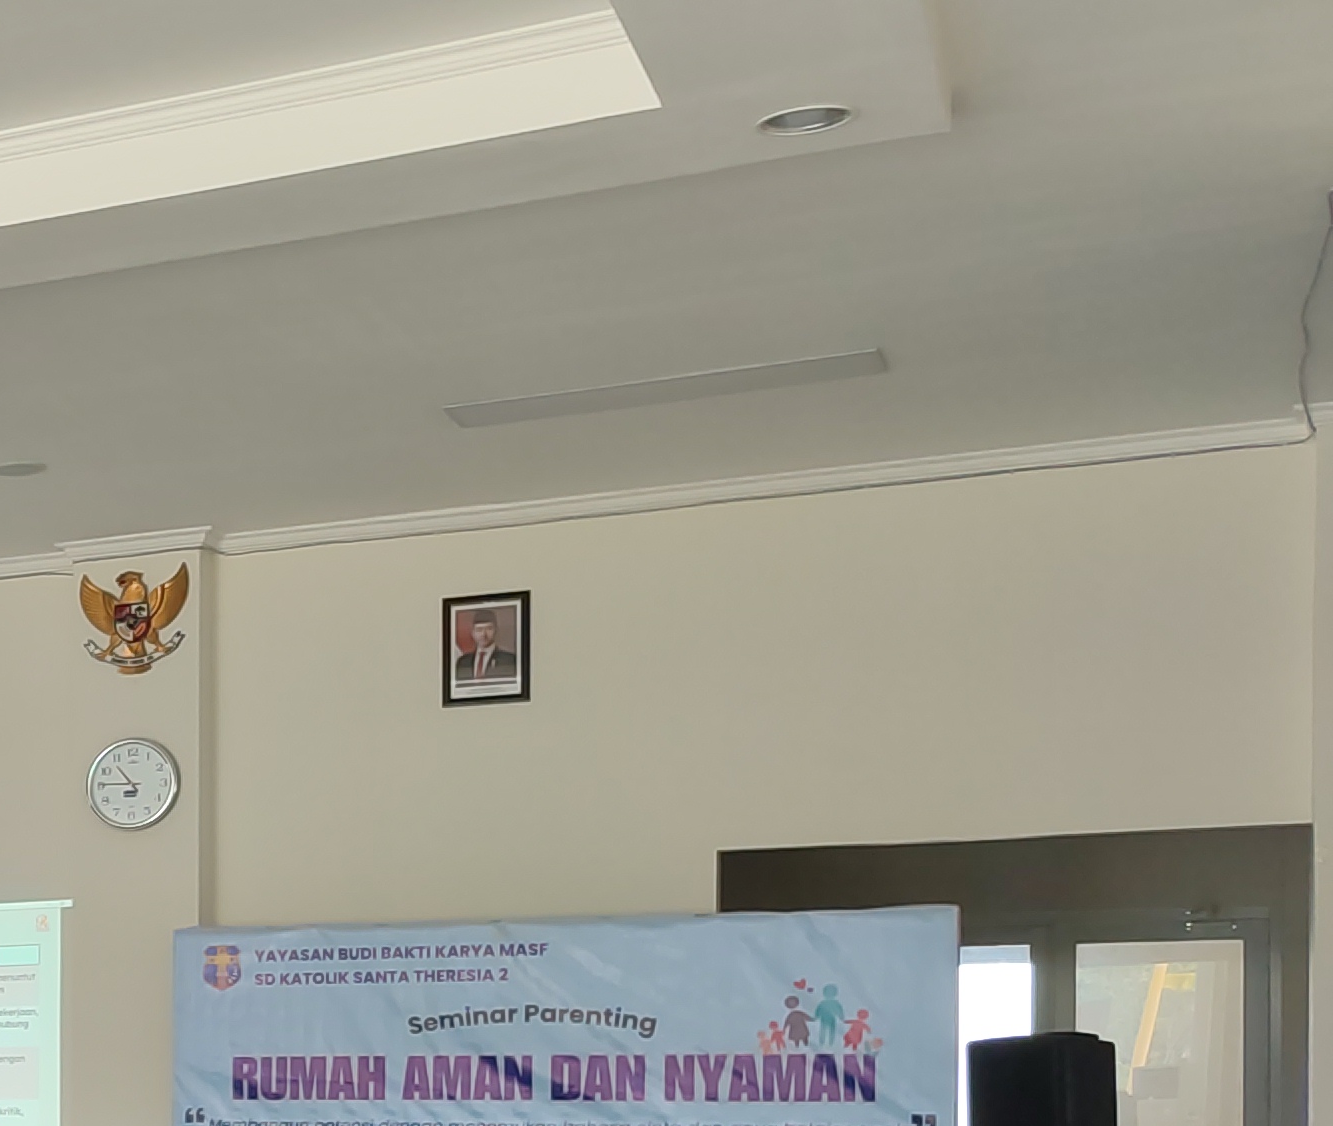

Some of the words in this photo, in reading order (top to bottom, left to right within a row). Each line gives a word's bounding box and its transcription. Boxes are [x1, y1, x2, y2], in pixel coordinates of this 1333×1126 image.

[255, 948, 334, 963] YAYASAN
[338, 947, 377, 961] BUDI
[382, 946, 432, 960] BAKTI
[435, 944, 495, 959] KARYA
[500, 943, 549, 958] MASF
[255, 972, 275, 986] SD
[279, 971, 349, 985] KATOLIK
[353, 970, 410, 985] SANTA
[414, 969, 495, 983] THERESIA
[499, 968, 509, 981] 2
[407, 1005, 518, 1034] Seminar
[524, 1004, 657, 1038] Parenting
[232, 1056, 386, 1101] RUMAH
[401, 1054, 533, 1101] AMAN
[550, 1054, 646, 1101] DAN
[664, 1054, 877, 1102] NYAMAN
